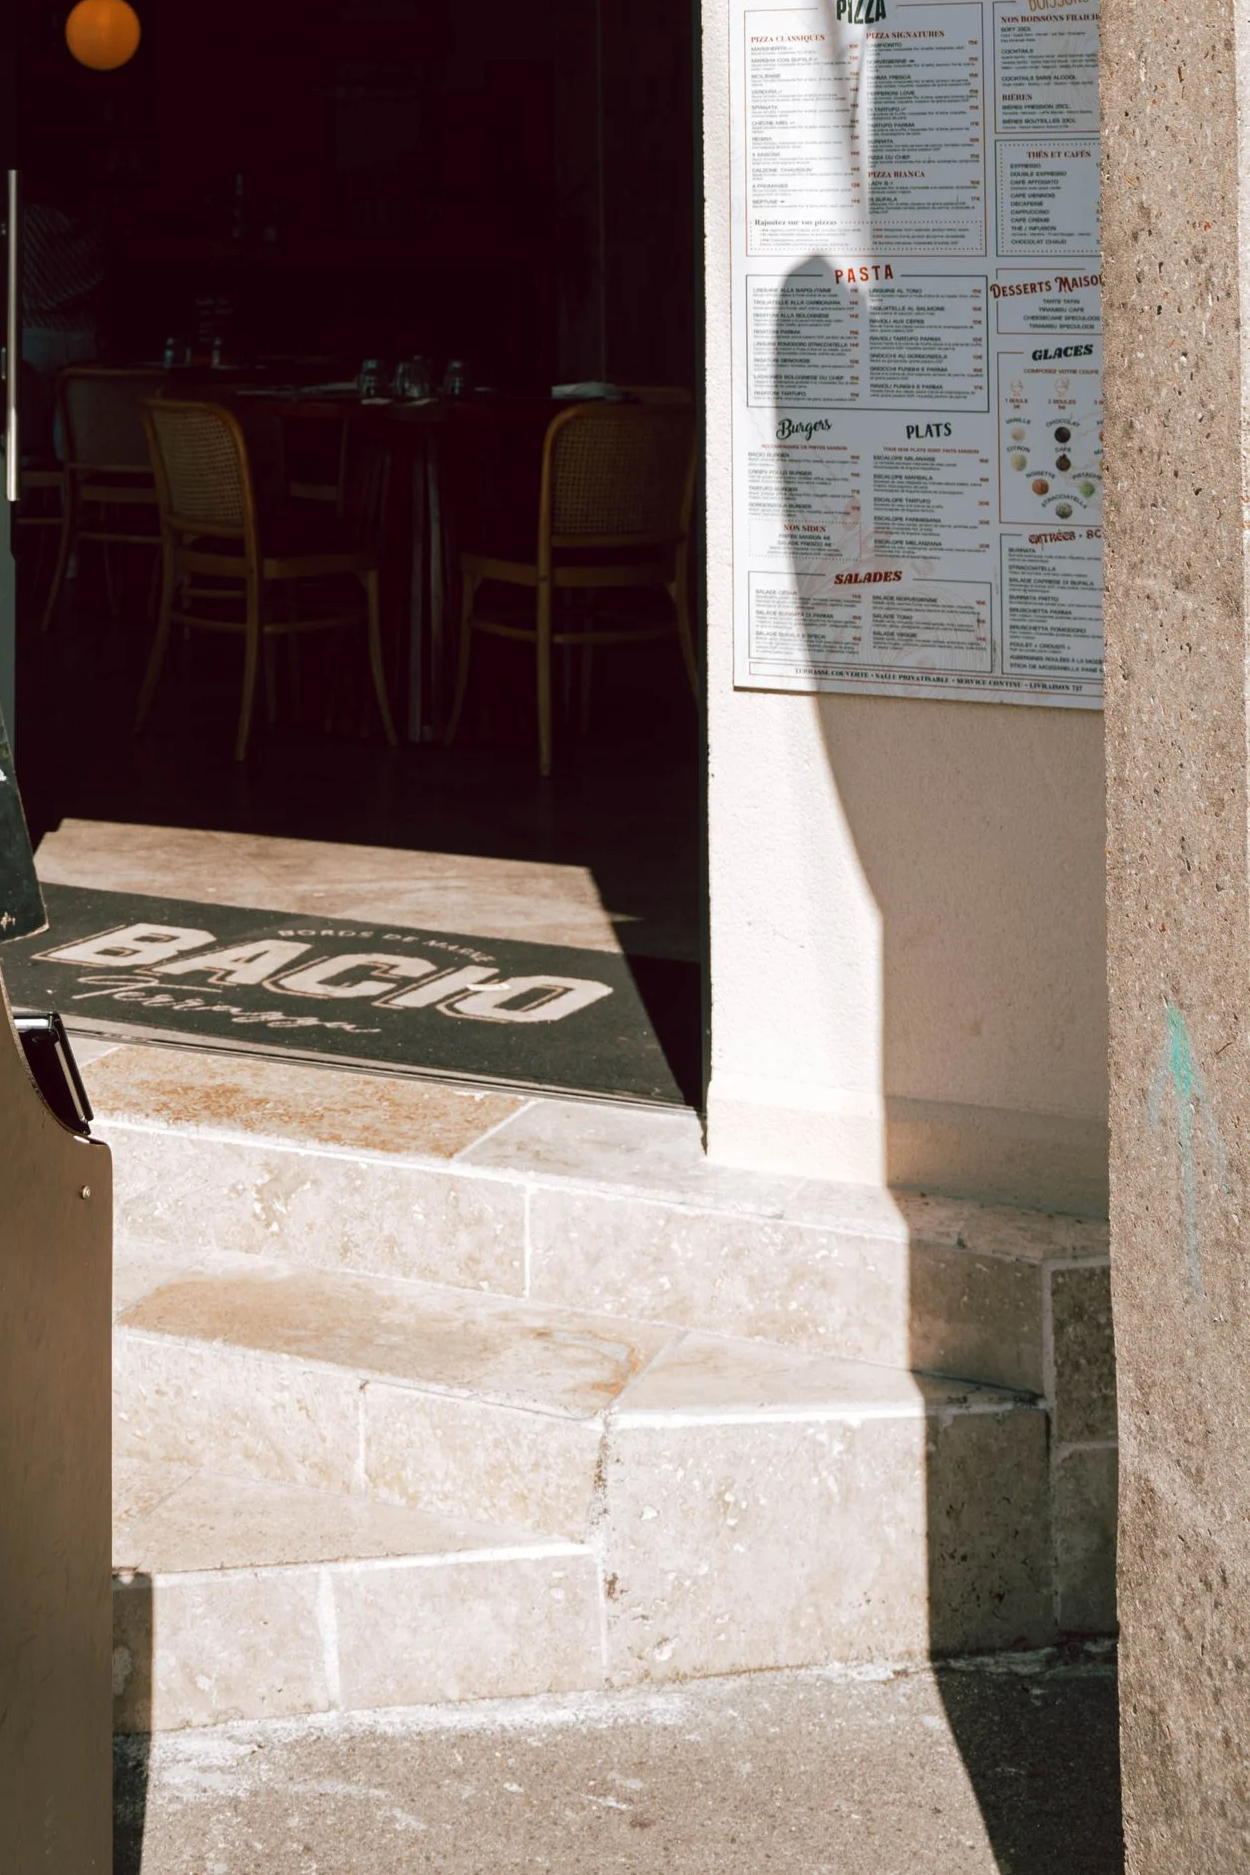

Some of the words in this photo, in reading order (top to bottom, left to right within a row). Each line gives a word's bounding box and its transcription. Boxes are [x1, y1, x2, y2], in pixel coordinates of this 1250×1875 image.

[866, 32, 890, 40] PIZZA
[892, 30, 945, 39] SIGNATURES
[835, 263, 894, 284] PASTA
[990, 280, 1052, 299] DESSERTS
[1031, 343, 1094, 361] GLACES
[776, 418, 833, 441] Burgers
[906, 422, 952, 440] PLATS
[834, 570, 903, 585] SALADES
[29, 922, 615, 1024] BACIO
[72, 973, 383, 1035] Terrazza
